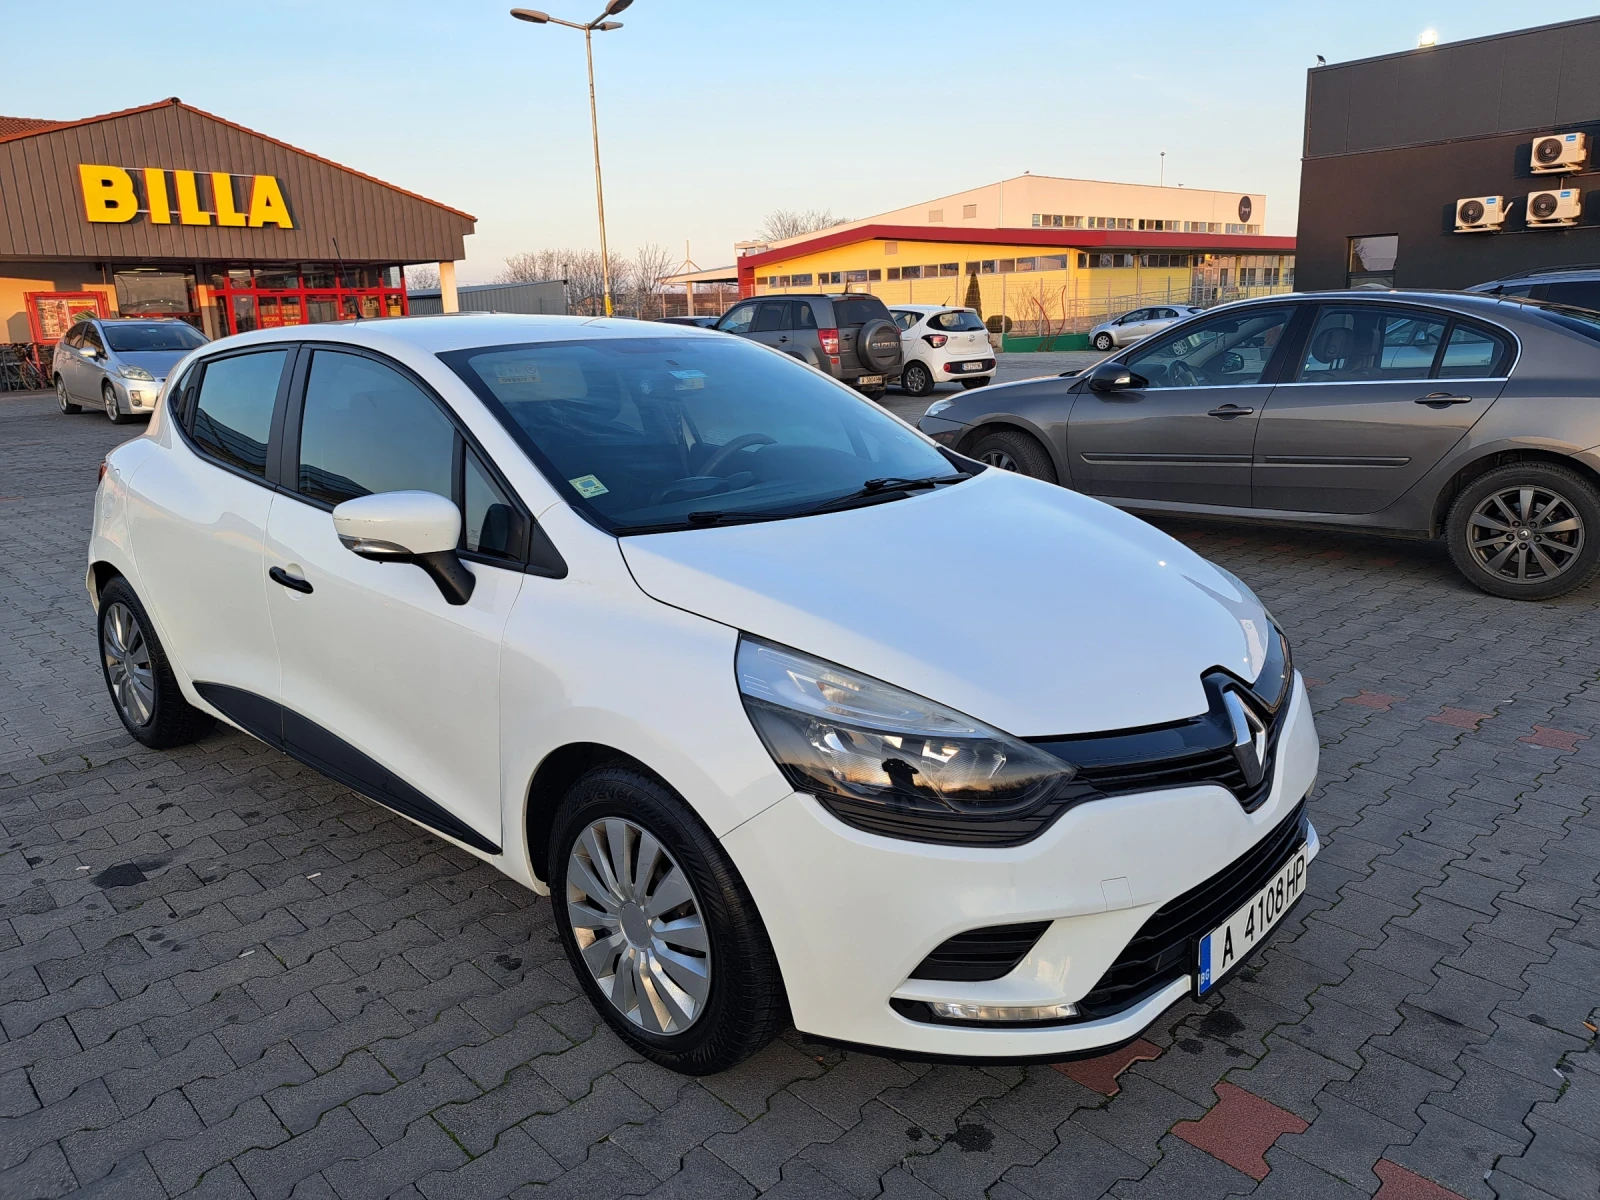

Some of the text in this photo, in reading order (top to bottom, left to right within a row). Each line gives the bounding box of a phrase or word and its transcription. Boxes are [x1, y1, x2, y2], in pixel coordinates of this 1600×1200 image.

[78, 163, 293, 229] BILLA
[872, 342, 899, 350] SUZUKI
[1221, 926, 1234, 969] A
[1200, 968, 1210, 985] BG
